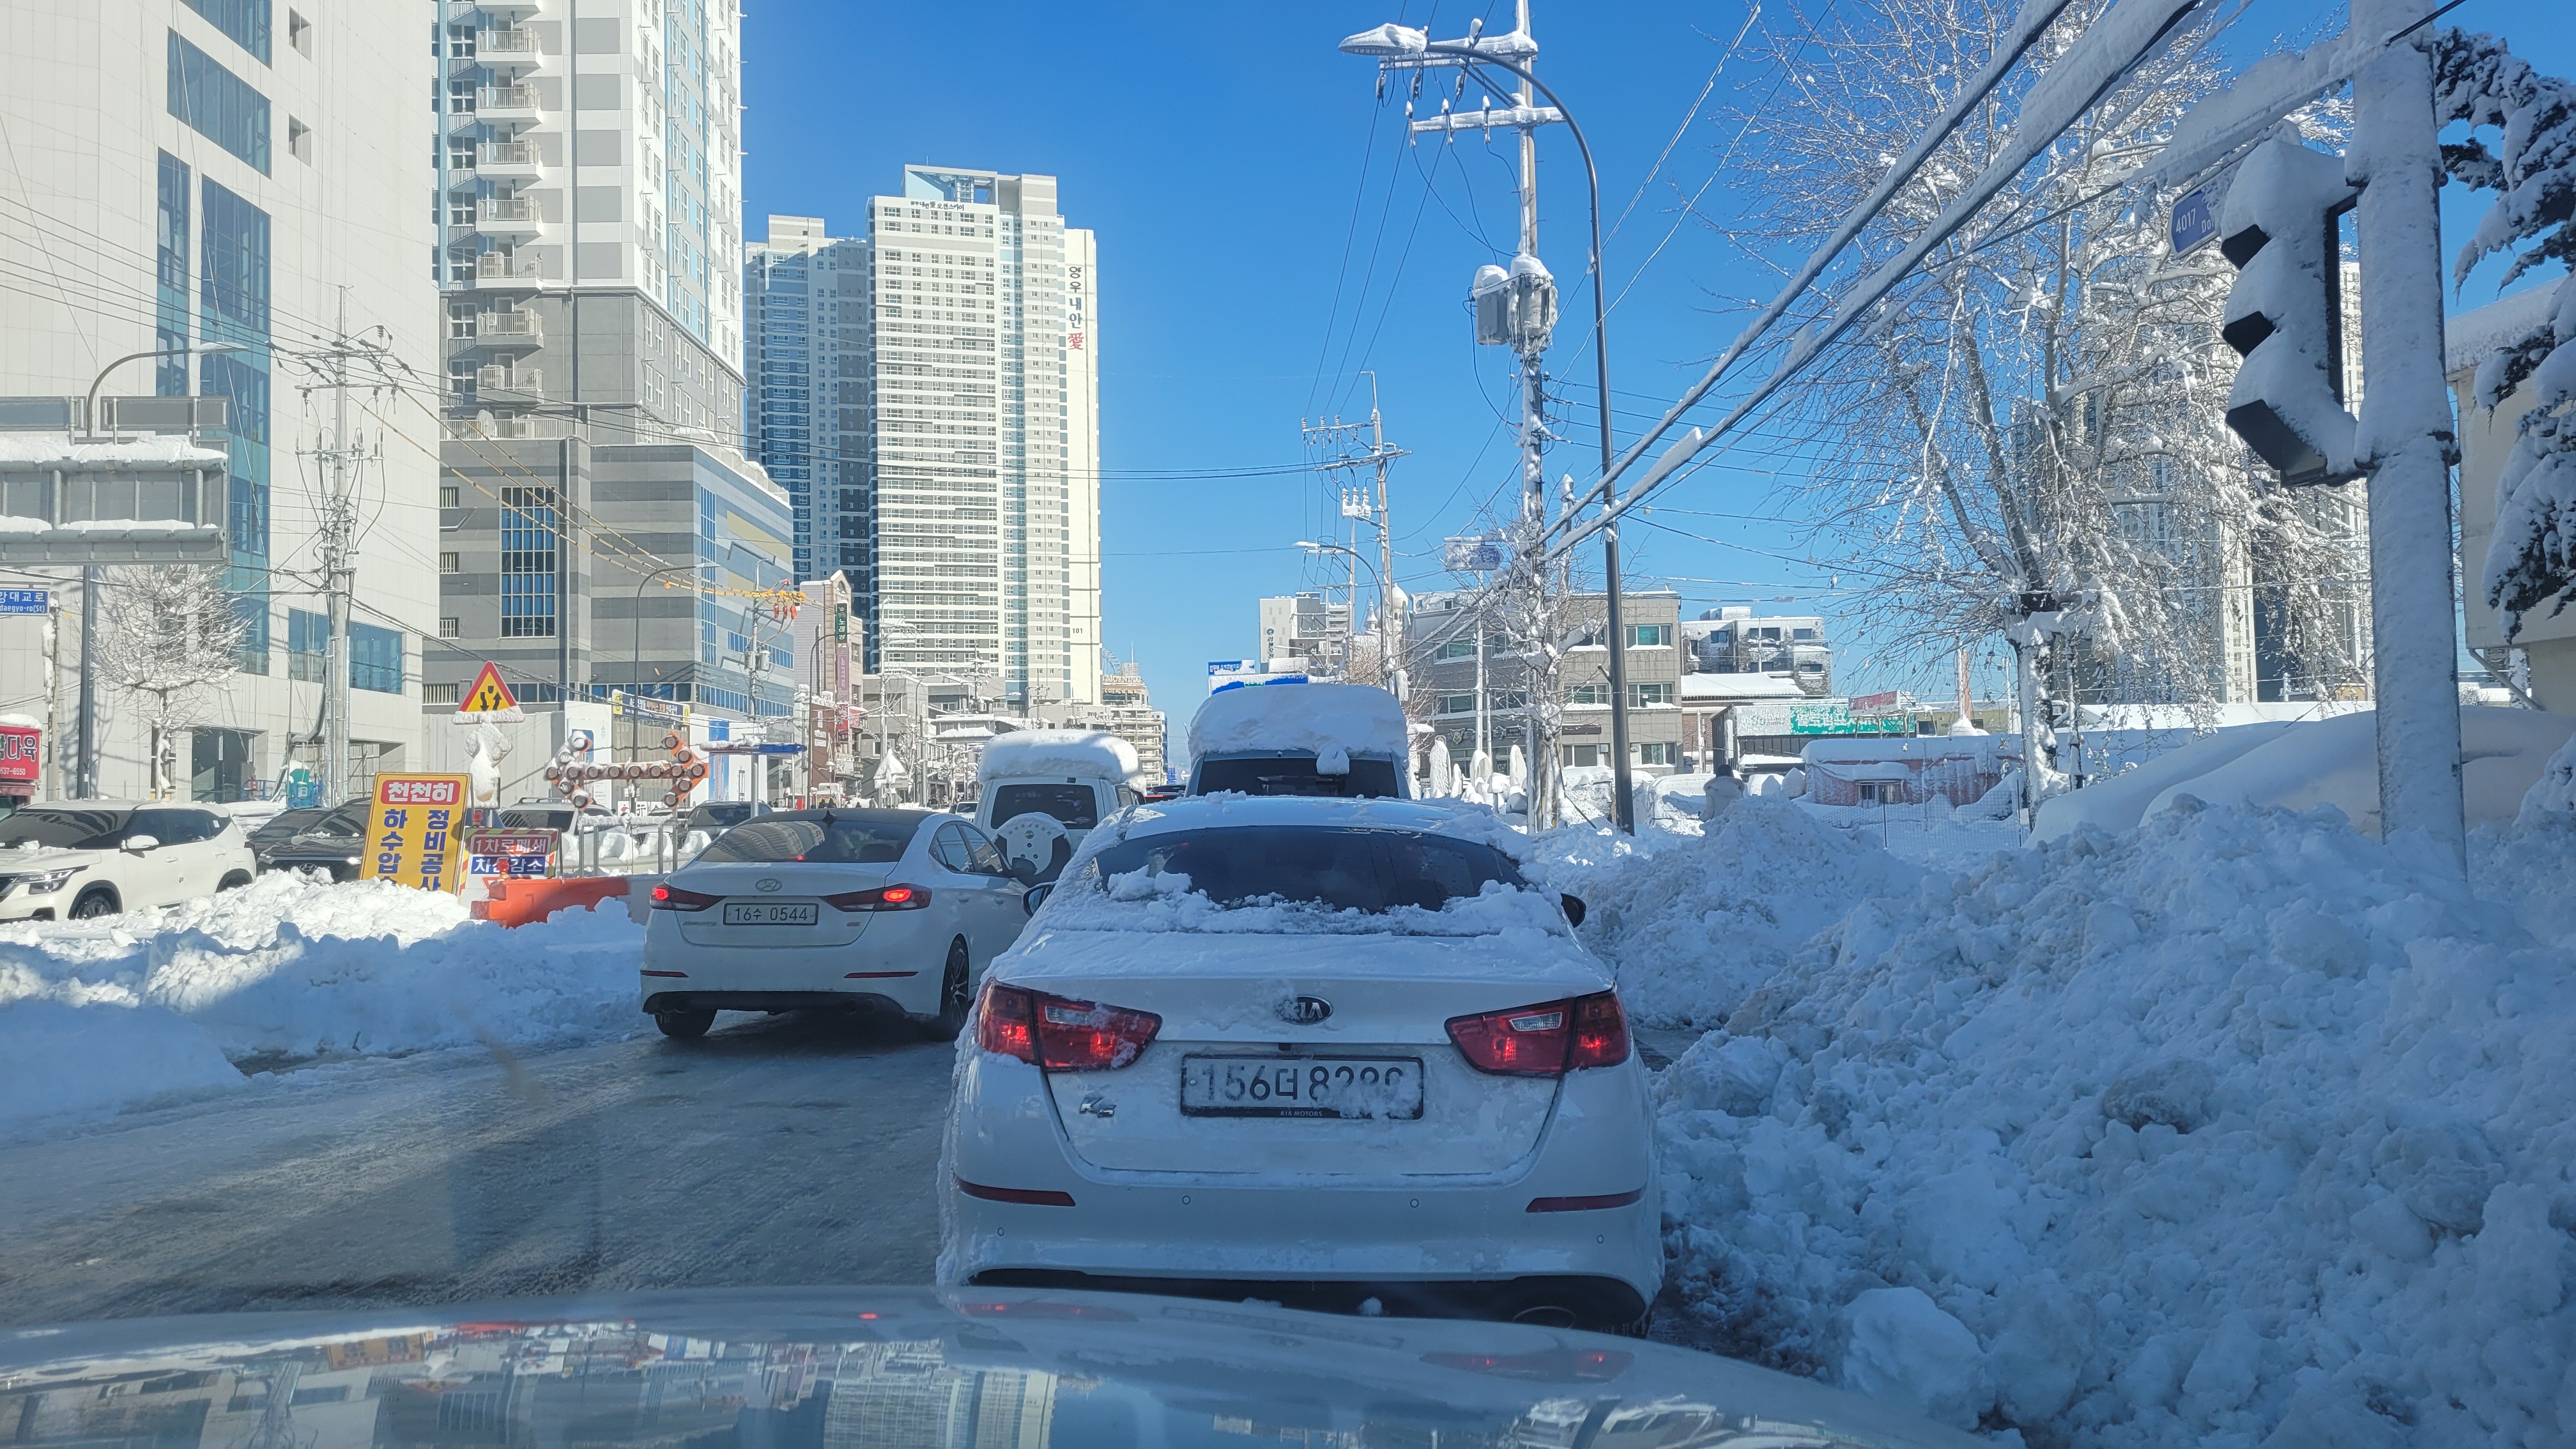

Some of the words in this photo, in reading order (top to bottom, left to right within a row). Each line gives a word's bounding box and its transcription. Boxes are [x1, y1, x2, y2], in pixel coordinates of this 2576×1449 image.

[2175, 208, 2196, 234] 4017
[1105, 675, 1141, 683] MORNING
[388, 782, 454, 802] 천천히
[735, 907, 762, 921] 16수
[770, 907, 808, 921] 0544
